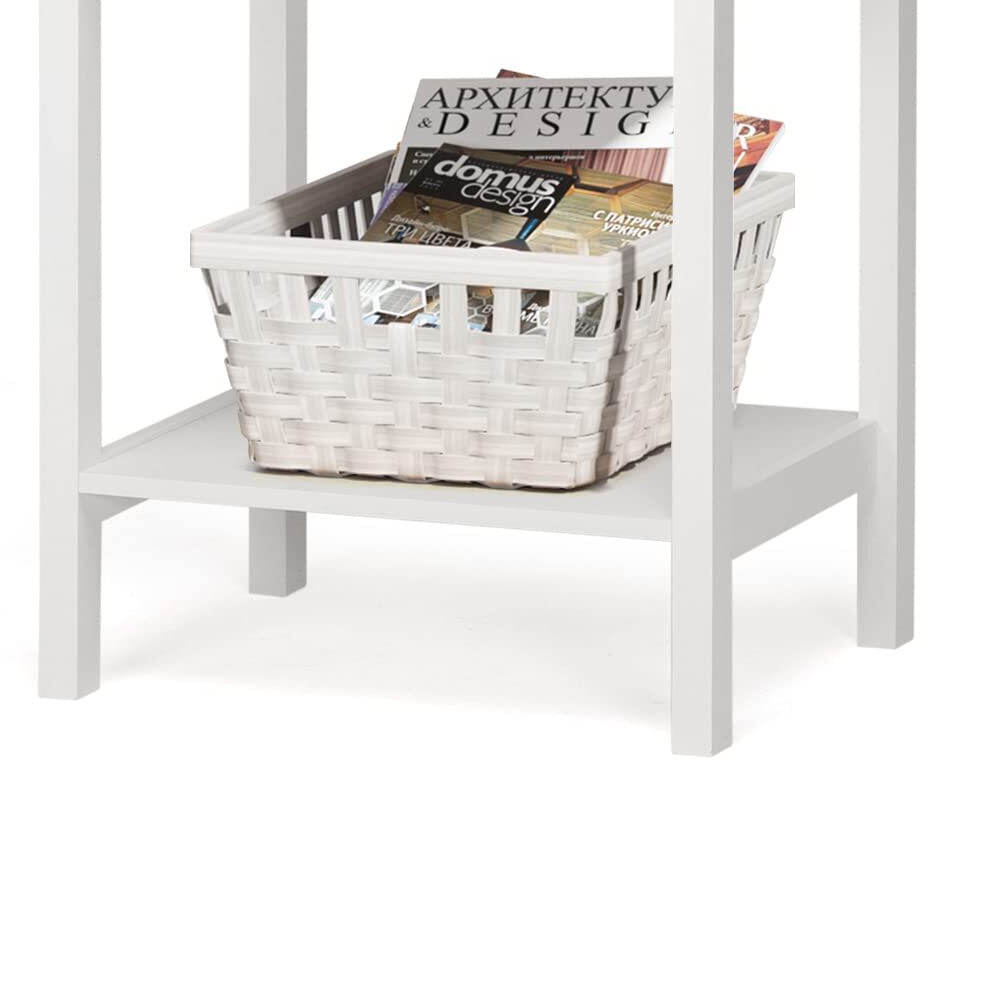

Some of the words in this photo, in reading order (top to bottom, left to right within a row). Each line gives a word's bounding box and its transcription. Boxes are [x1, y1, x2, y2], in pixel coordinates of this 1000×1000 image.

[433, 110, 674, 137] DESIG
[433, 154, 560, 196] domus
[460, 178, 556, 216] design
[384, 222, 419, 240] ТРИ
[601, 222, 656, 239] УРКИО
